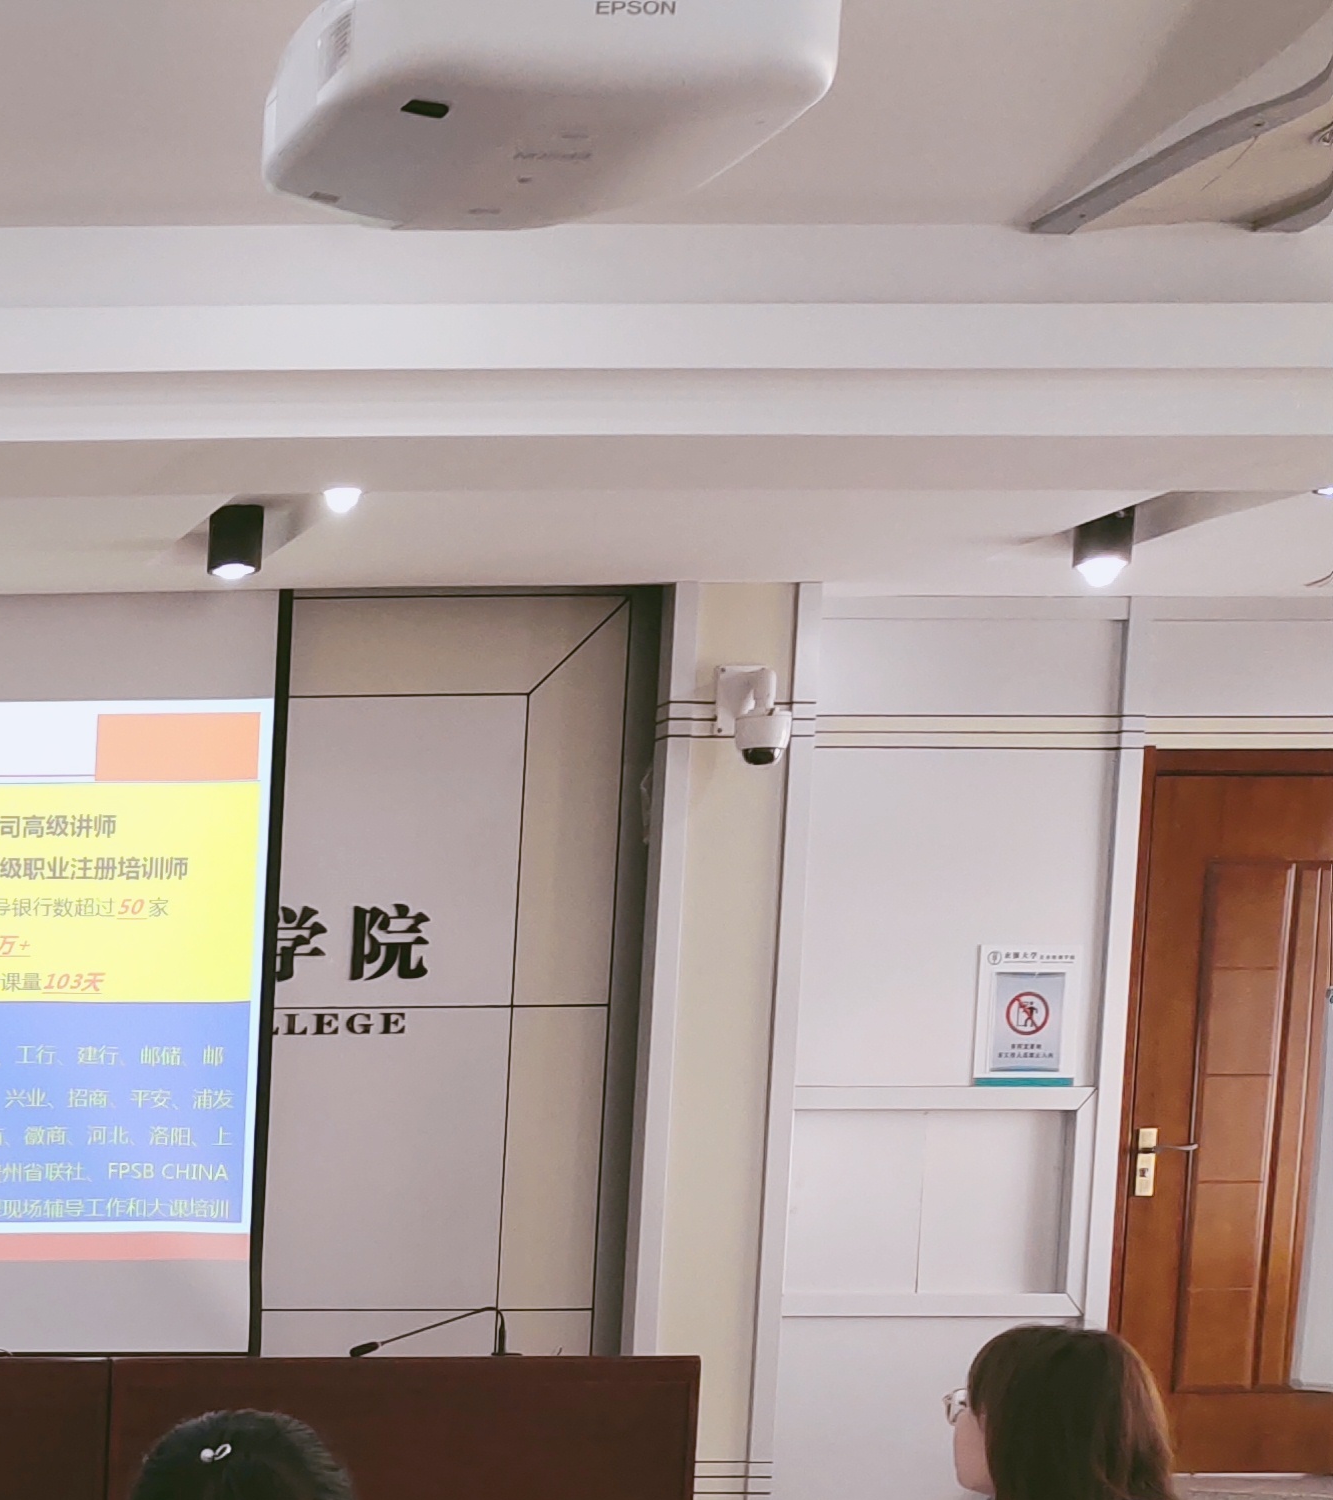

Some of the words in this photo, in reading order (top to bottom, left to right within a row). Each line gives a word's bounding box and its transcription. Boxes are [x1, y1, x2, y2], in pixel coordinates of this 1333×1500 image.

[596, 1, 676, 15] EPSON
[273, 1012, 407, 1036] LEGE
[161, 1163, 229, 1181] CHINA
